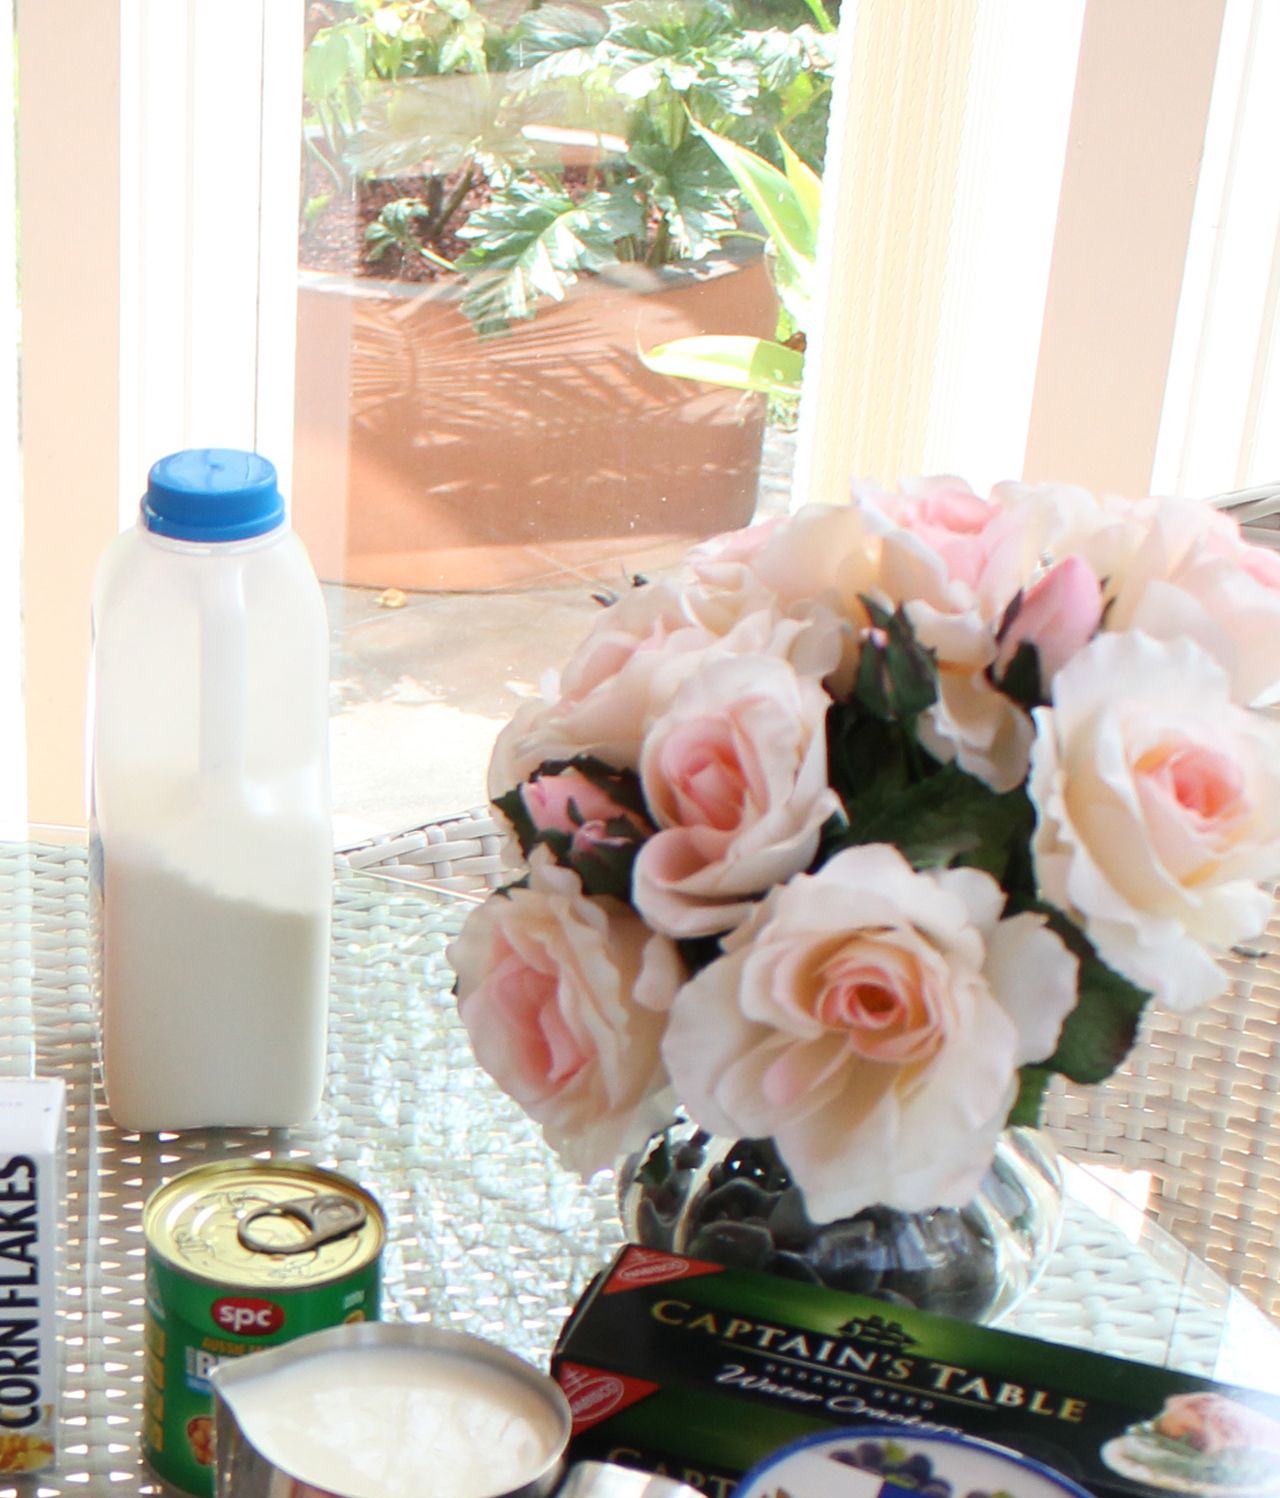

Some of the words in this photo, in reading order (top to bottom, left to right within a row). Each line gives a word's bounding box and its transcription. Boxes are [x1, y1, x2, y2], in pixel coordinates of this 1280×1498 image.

[219, 1304, 274, 1331] spc
[650, 1298, 914, 1380] CAPTAIN'S
[928, 1361, 1089, 1423] TABLE
[715, 1363, 824, 1402] Water
